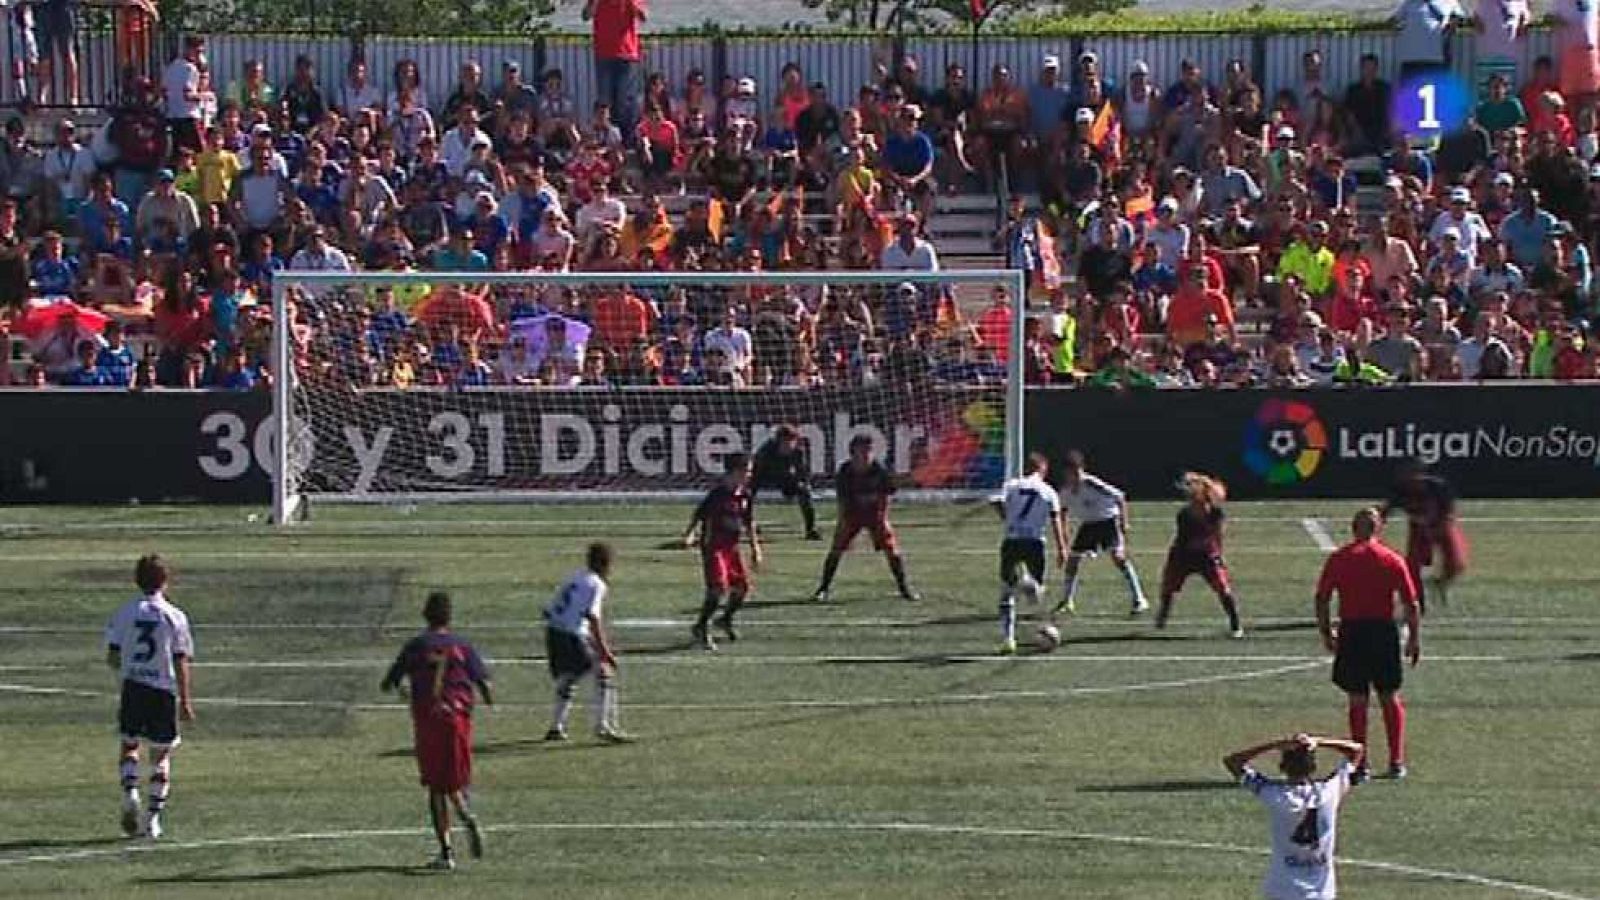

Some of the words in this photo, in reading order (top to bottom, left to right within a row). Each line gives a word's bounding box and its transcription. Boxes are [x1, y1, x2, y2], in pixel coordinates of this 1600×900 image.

[200, 412, 314, 479] 30
[345, 426, 394, 496] y
[426, 410, 504, 477] 31
[1339, 423, 1600, 465] LaLigaNonSto
[1019, 488, 1038, 520] 7
[134, 619, 157, 664] 3
[427, 651, 449, 698] 7
[1290, 807, 1320, 850] 4
